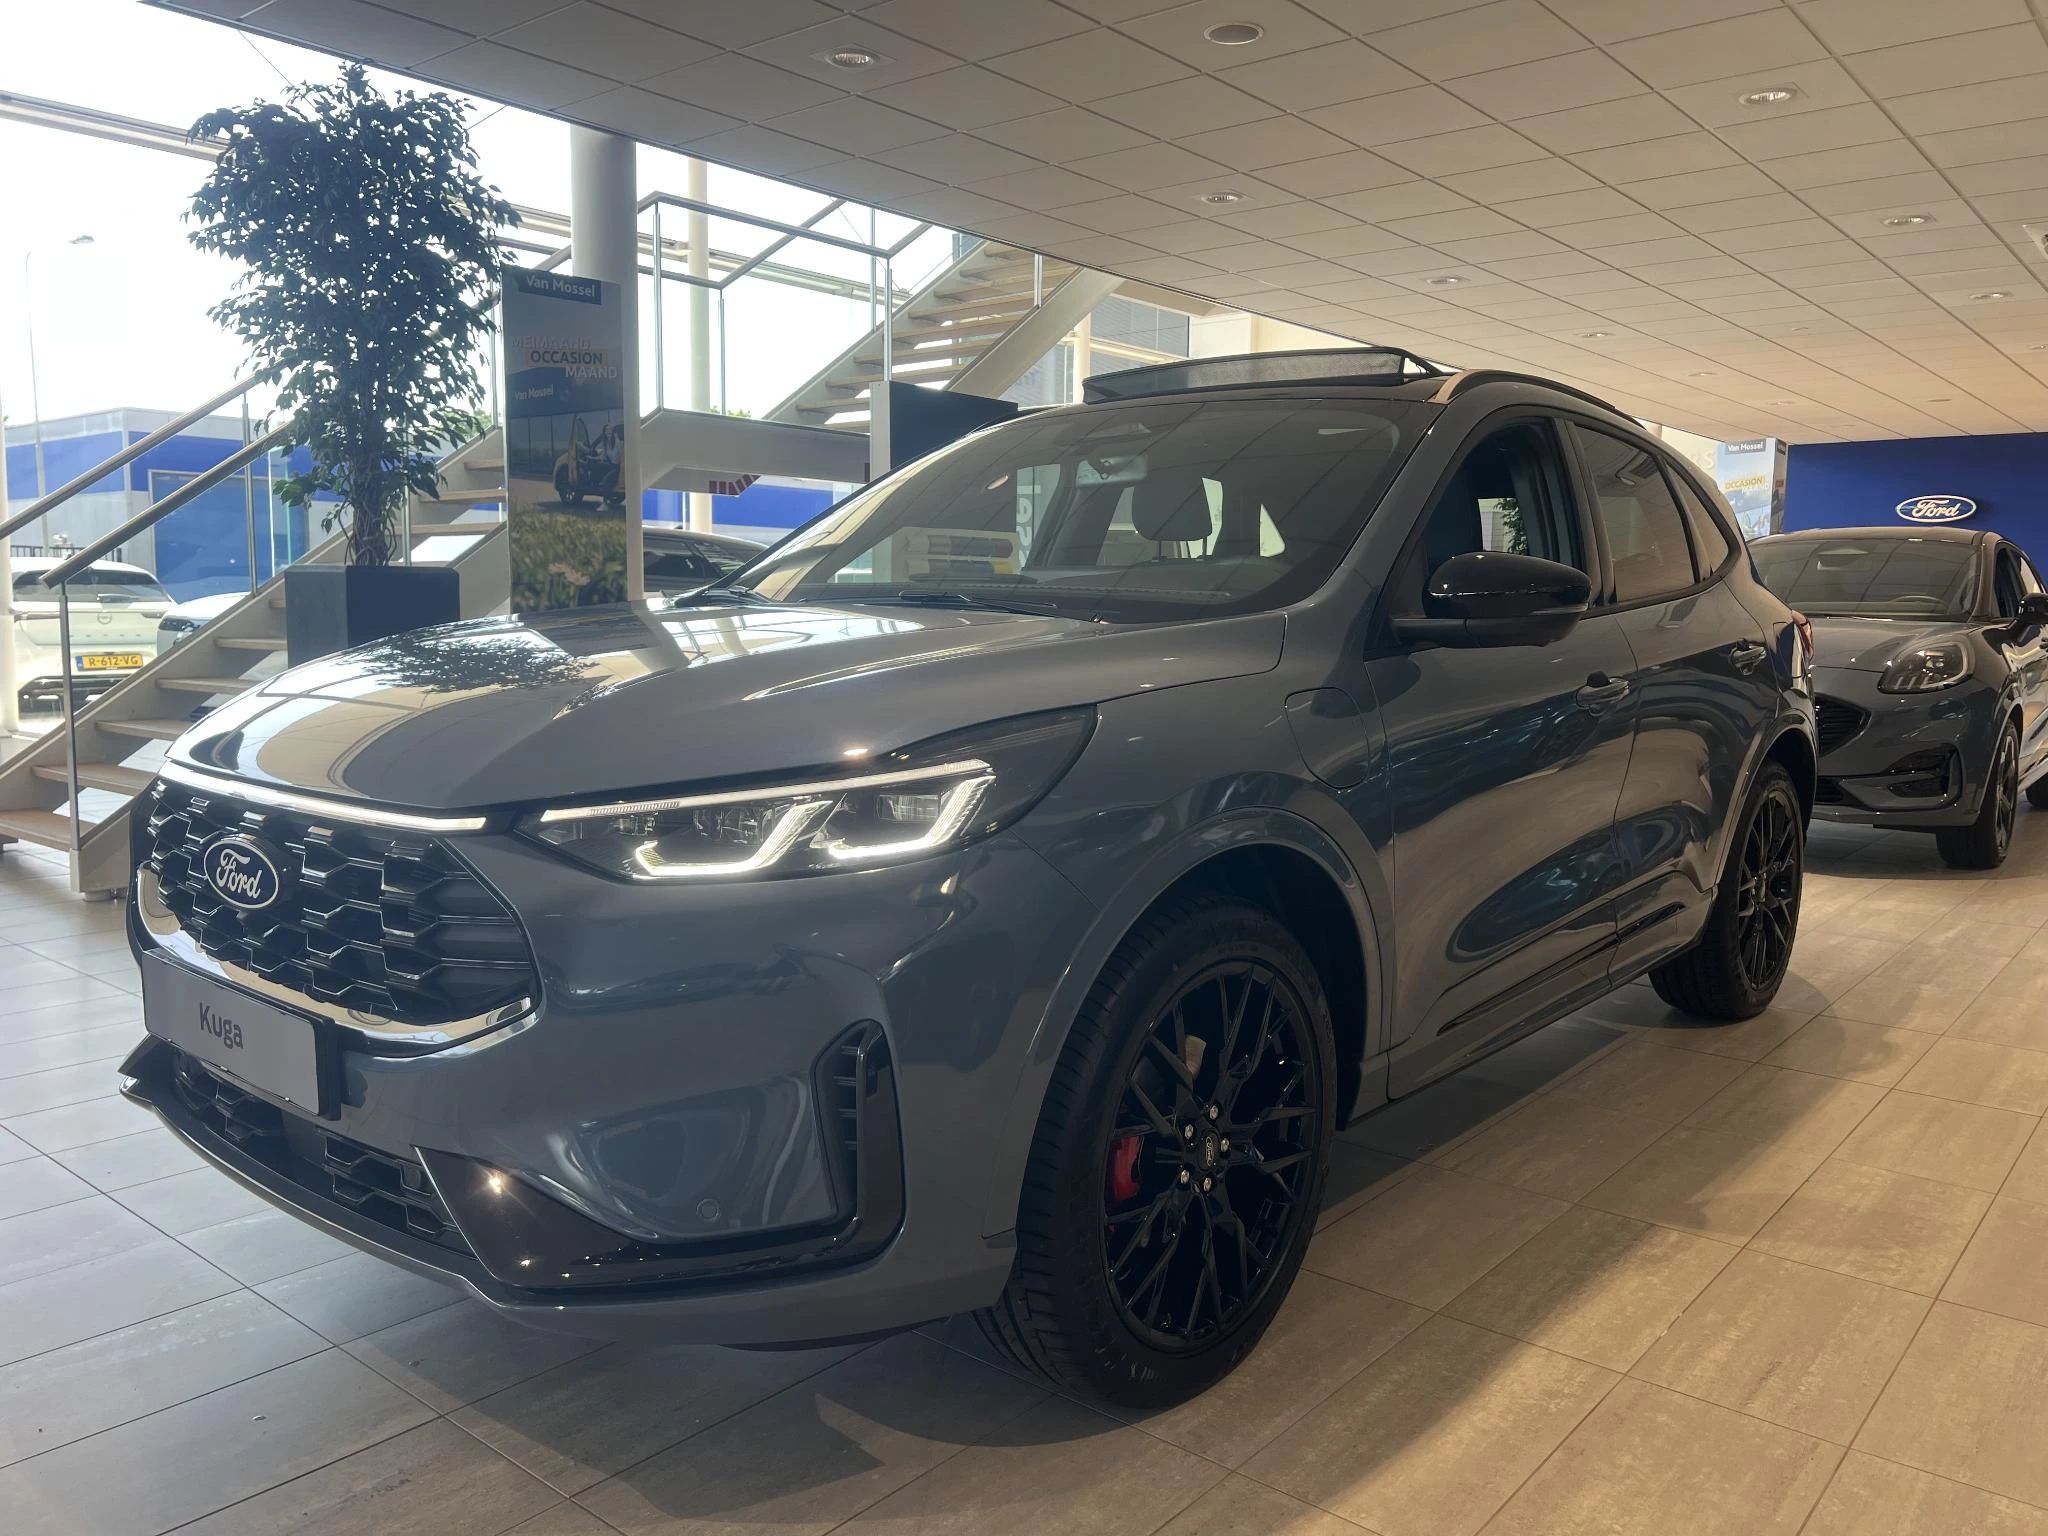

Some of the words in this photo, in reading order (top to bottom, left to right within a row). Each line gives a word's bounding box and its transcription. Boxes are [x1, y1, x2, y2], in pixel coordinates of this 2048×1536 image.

[526, 275, 549, 290] Van
[553, 279, 596, 297] Mossel
[530, 350, 603, 365] OCCASION
[565, 366, 618, 379] MAAND
[1727, 444, 1740, 452] Van
[1740, 441, 1764, 451] Mossel
[1725, 476, 1763, 490] OCCASION
[1911, 499, 1961, 518] Ford
[88, 655, 139, 667] R-612-VG
[216, 848, 262, 899] Ford
[199, 1002, 244, 1050] Kuga
